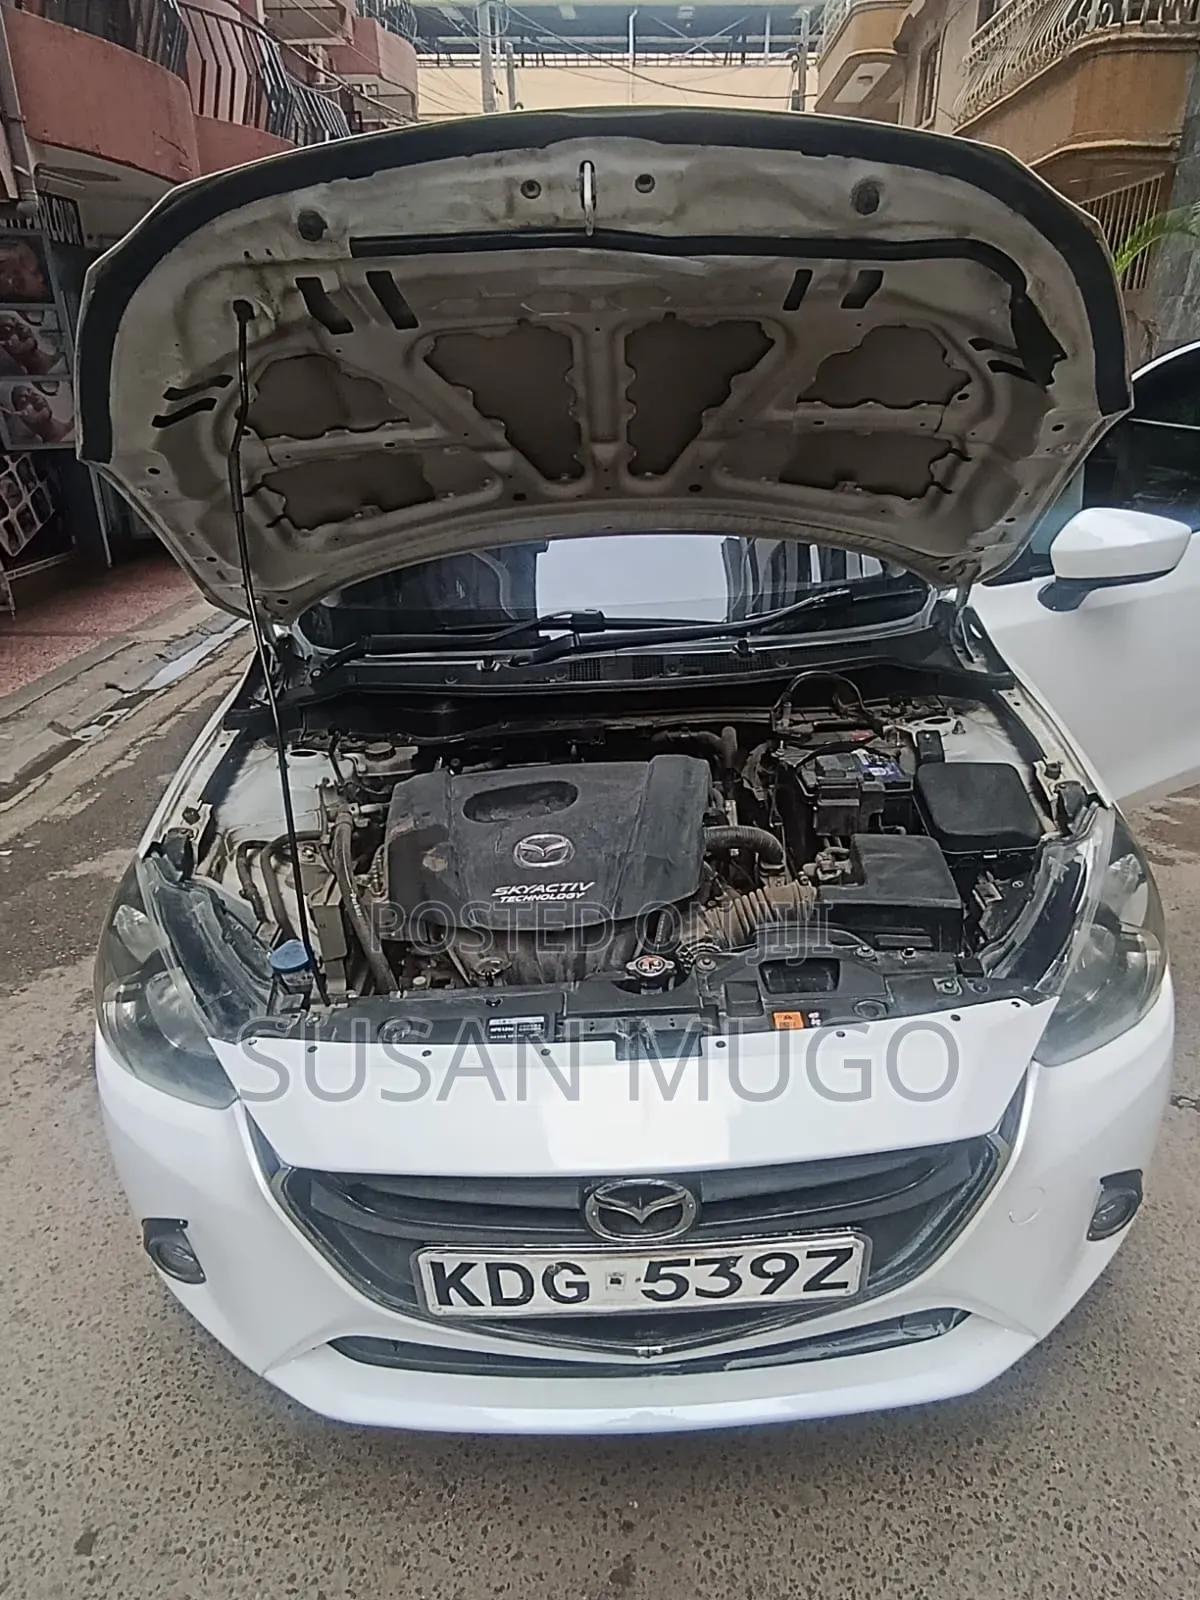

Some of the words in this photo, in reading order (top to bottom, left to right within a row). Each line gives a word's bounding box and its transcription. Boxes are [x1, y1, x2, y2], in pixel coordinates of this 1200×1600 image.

[491, 881, 596, 897] SKYACTIV
[499, 892, 585, 903] TECHNOLOGY
[430, 1260, 590, 1307] KDG
[640, 1248, 855, 1302] 539Z
